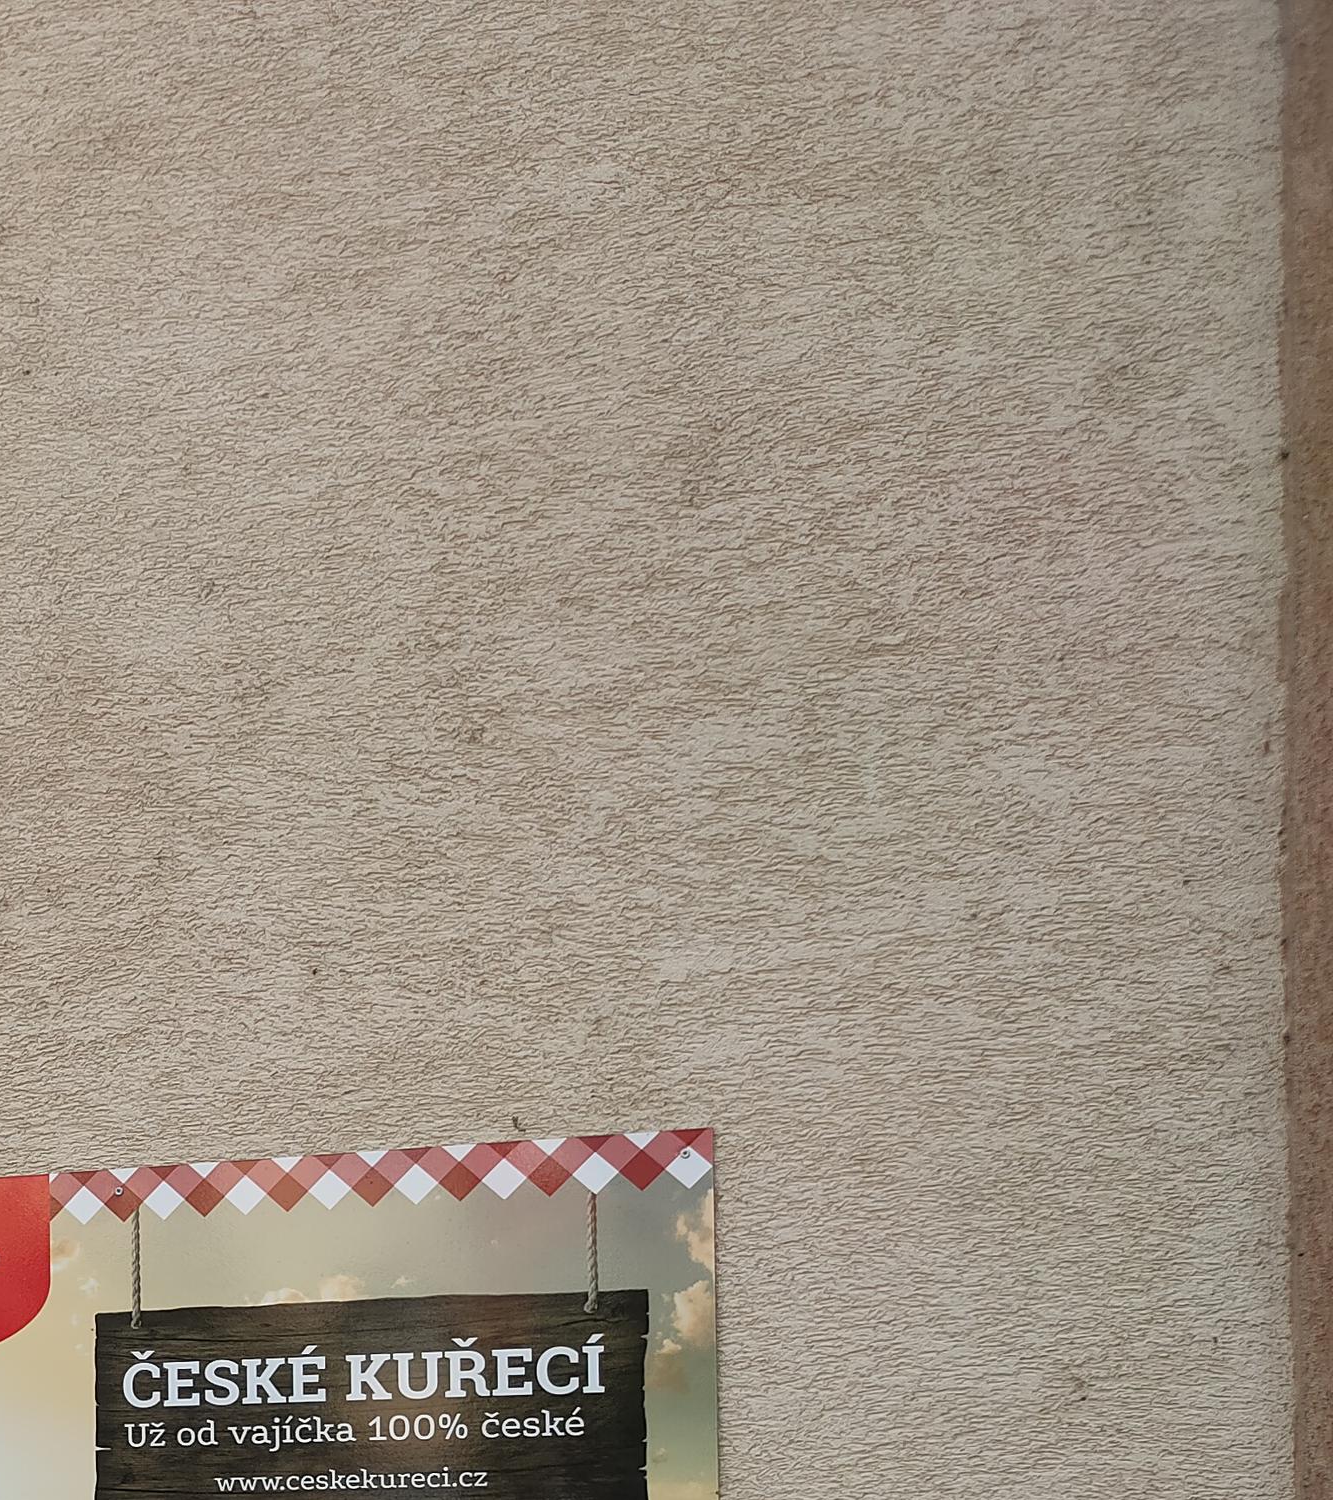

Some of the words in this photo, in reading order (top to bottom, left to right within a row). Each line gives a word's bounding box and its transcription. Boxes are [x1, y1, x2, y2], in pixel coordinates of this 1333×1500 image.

[121, 1345, 328, 1409] ČESKÉ
[345, 1333, 607, 1401] KUŘECÍ
[123, 1418, 167, 1449] Už
[176, 1420, 218, 1447] od
[228, 1415, 356, 1452] vajíčka
[368, 1412, 469, 1441] 100%
[480, 1407, 586, 1438] české
[214, 1467, 488, 1493] www.ceskekureci.cz
